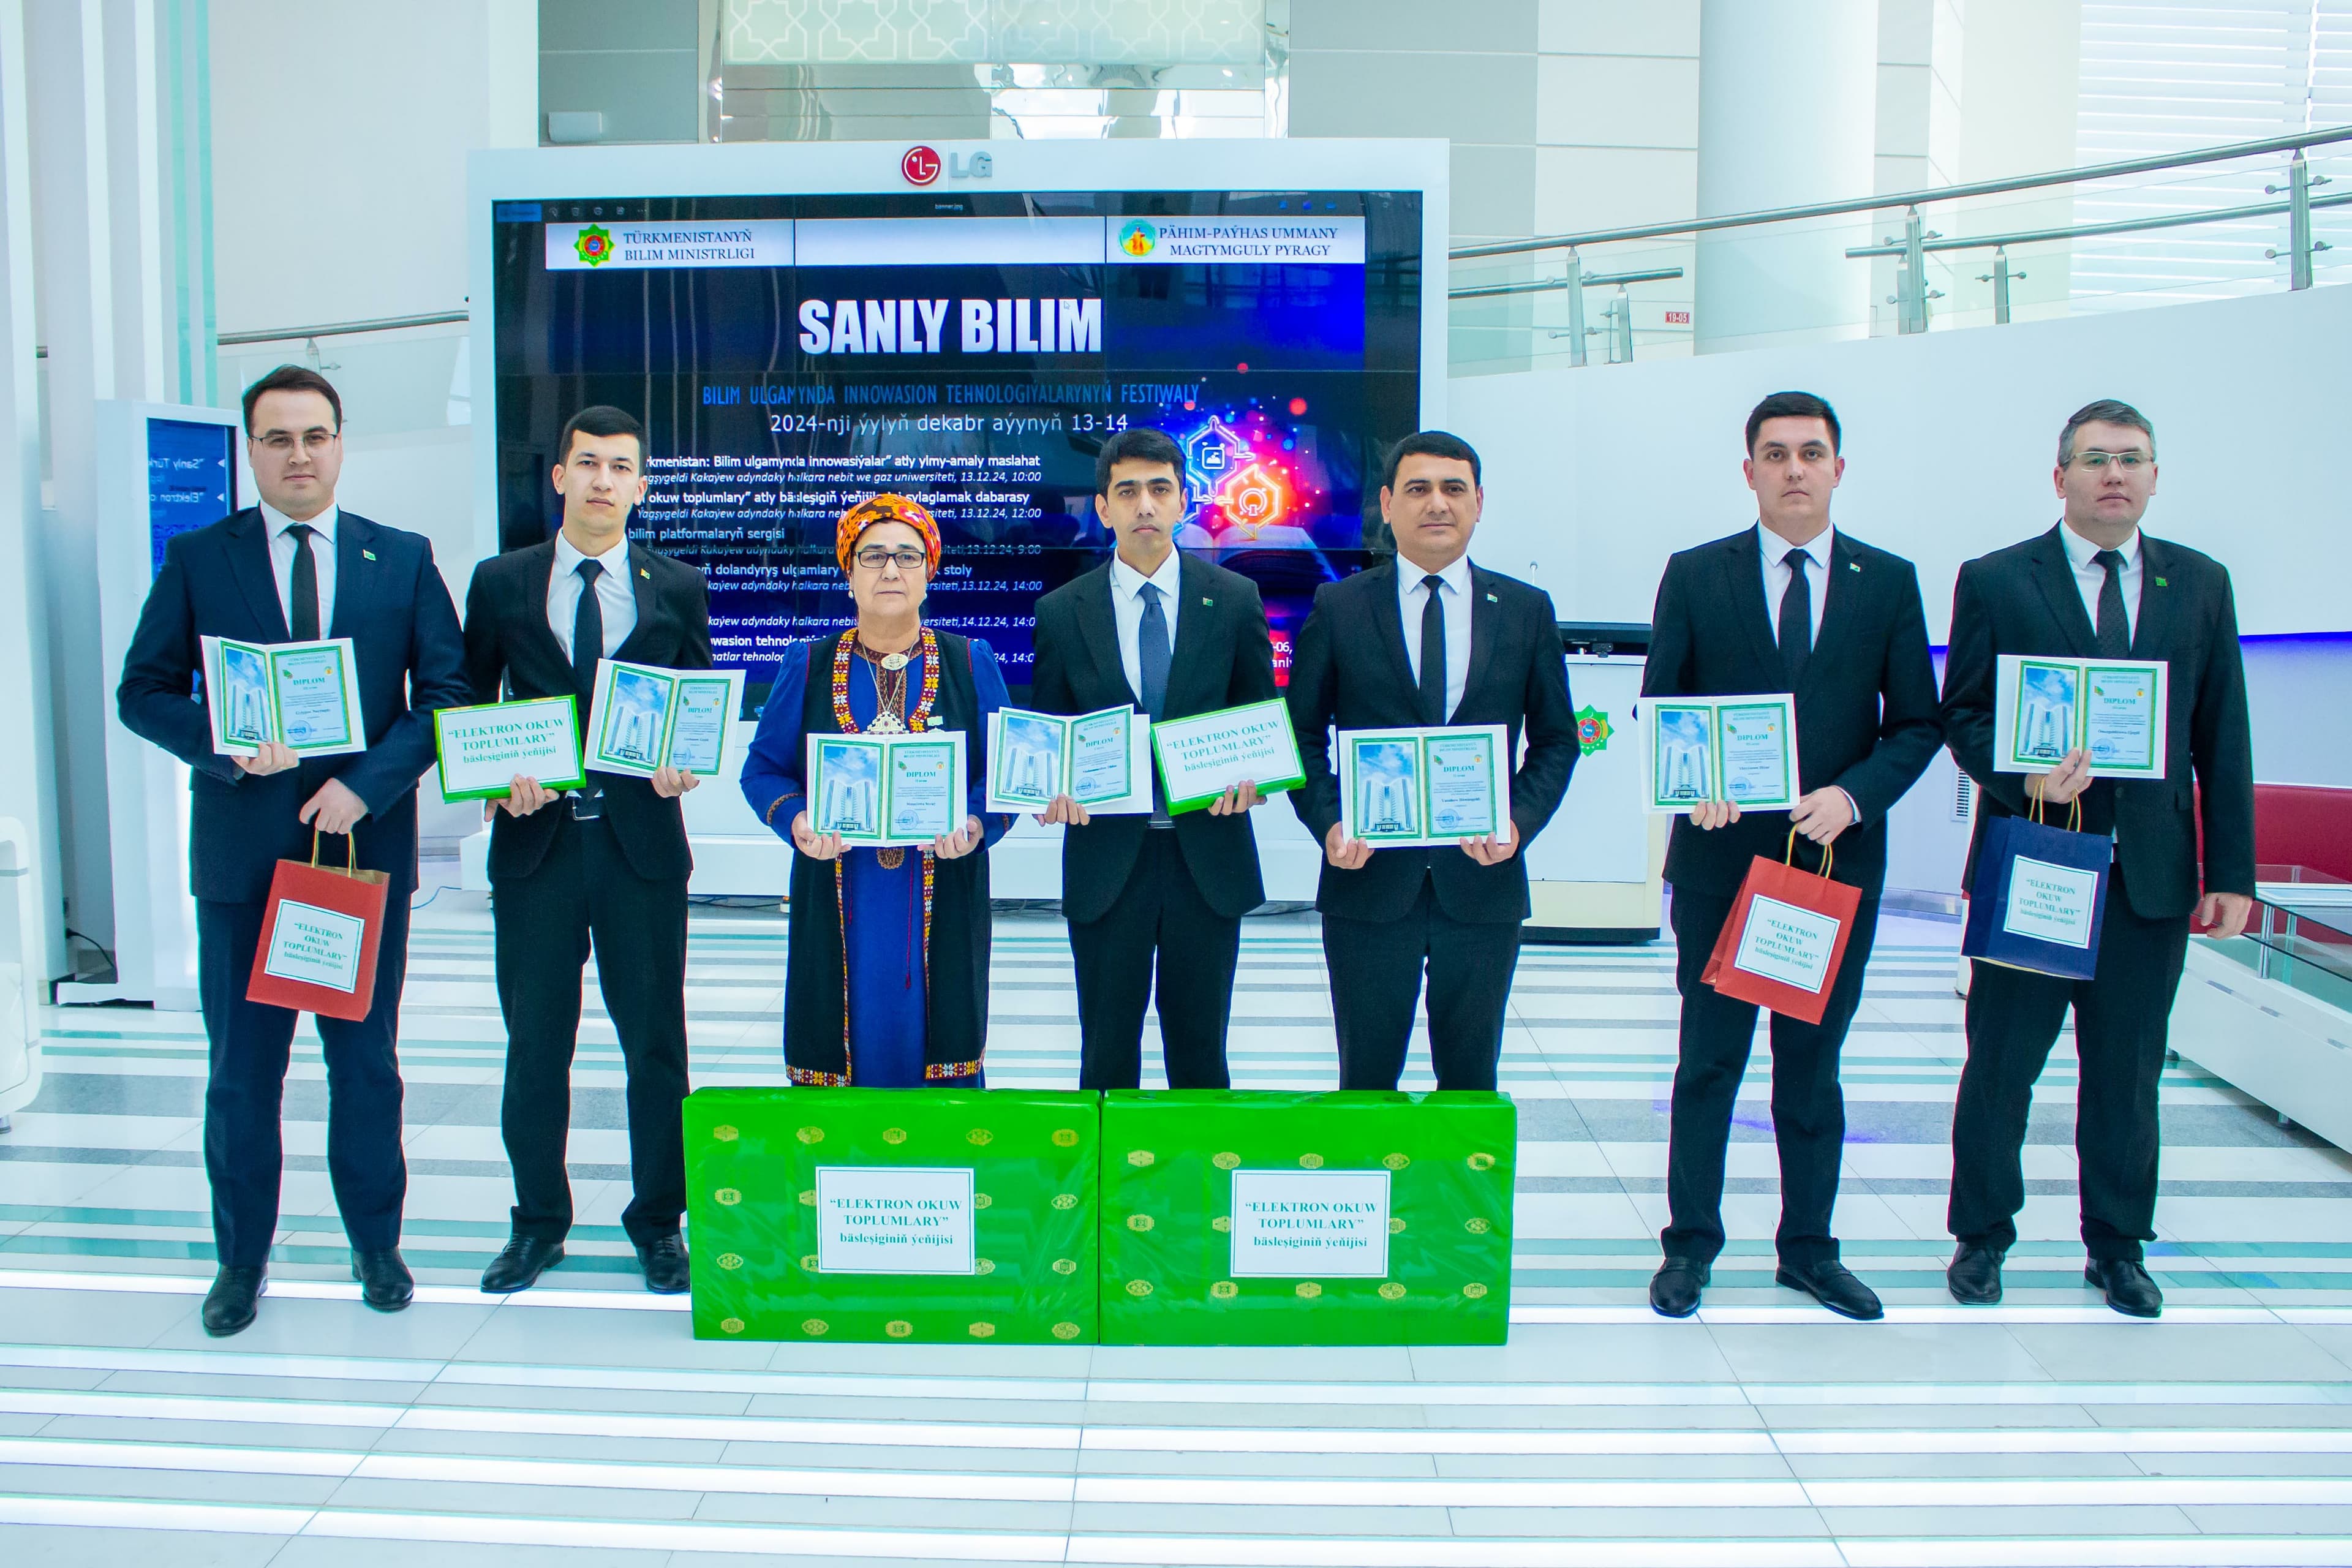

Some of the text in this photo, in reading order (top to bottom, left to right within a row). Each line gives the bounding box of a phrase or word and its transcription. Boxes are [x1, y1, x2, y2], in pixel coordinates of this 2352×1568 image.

[951, 151, 992, 178] LG
[623, 228, 753, 244] TÜRKMENISTANYŇ
[1159, 225, 1338, 239] PÄHIM-PAÝHAS UMMANY
[625, 248, 755, 261] BILIM MINISTRLIGI
[1170, 244, 1331, 256] MAGTYMGULY PYRAGY
[1668, 312, 1687, 322] 19-05
[799, 298, 1102, 355] SANLY BILIM
[703, 386, 741, 405] BILIM
[844, 385, 937, 404] INNOWASION
[1121, 384, 1199, 403] FESTIWALY
[771, 412, 1128, 435] 2024-nji ýylyň dekabr aýynyň 13-14
[714, 456, 742, 467] Bilim
[745, 455, 805, 469] ulgamynda
[894, 455, 916, 469] atly
[919, 454, 984, 469] ylmy-amaly
[988, 454, 1041, 466] maslahat
[691, 472, 734, 484] Kakaýew
[737, 472, 785, 484] adyndaky
[788, 472, 825, 482] halkara
[828, 472, 854, 482] nebit
[857, 473, 871, 482] we
[874, 473, 892, 484] gaz
[895, 472, 957, 483] uniwersiteti,
[960, 472, 1008, 483] 13.12.24,
[1011, 472, 1041, 481] 10:00
[649, 492, 680, 503] okuw
[754, 491, 776, 505] atly
[779, 491, 837, 505] bäsleşigiň
[975, 491, 1030, 505] dabarasy
[637, 507, 689, 520] Ýagşygeldi
[691, 508, 735, 520] Kakaýew
[737, 508, 785, 520] adyndaky
[788, 508, 826, 518] halkara
[960, 508, 1008, 519] 13.12.24,
[1012, 508, 1041, 518] 12:00
[628, 527, 785, 542] bilim platformalaryň sergisi
[715, 564, 778, 577] dolandyryş
[944, 564, 972, 577] stoly
[741, 580, 790, 592] adyndaky
[1012, 581, 1042, 591] 14:00
[741, 616, 790, 628] adyndaky
[293, 677, 325, 685] DIPLOM
[526, 718, 565, 731] OKUW
[1242, 720, 1280, 735] OKUW
[1085, 737, 1113, 748] DIPLOM
[918, 1200, 962, 1210] OKUW
[1333, 1202, 1378, 1213] OKUW
[840, 1232, 953, 1246] bäsleşiginiň ýeňijisi
[1254, 1236, 1368, 1250] bäsleşiginiň ýeňijisi
